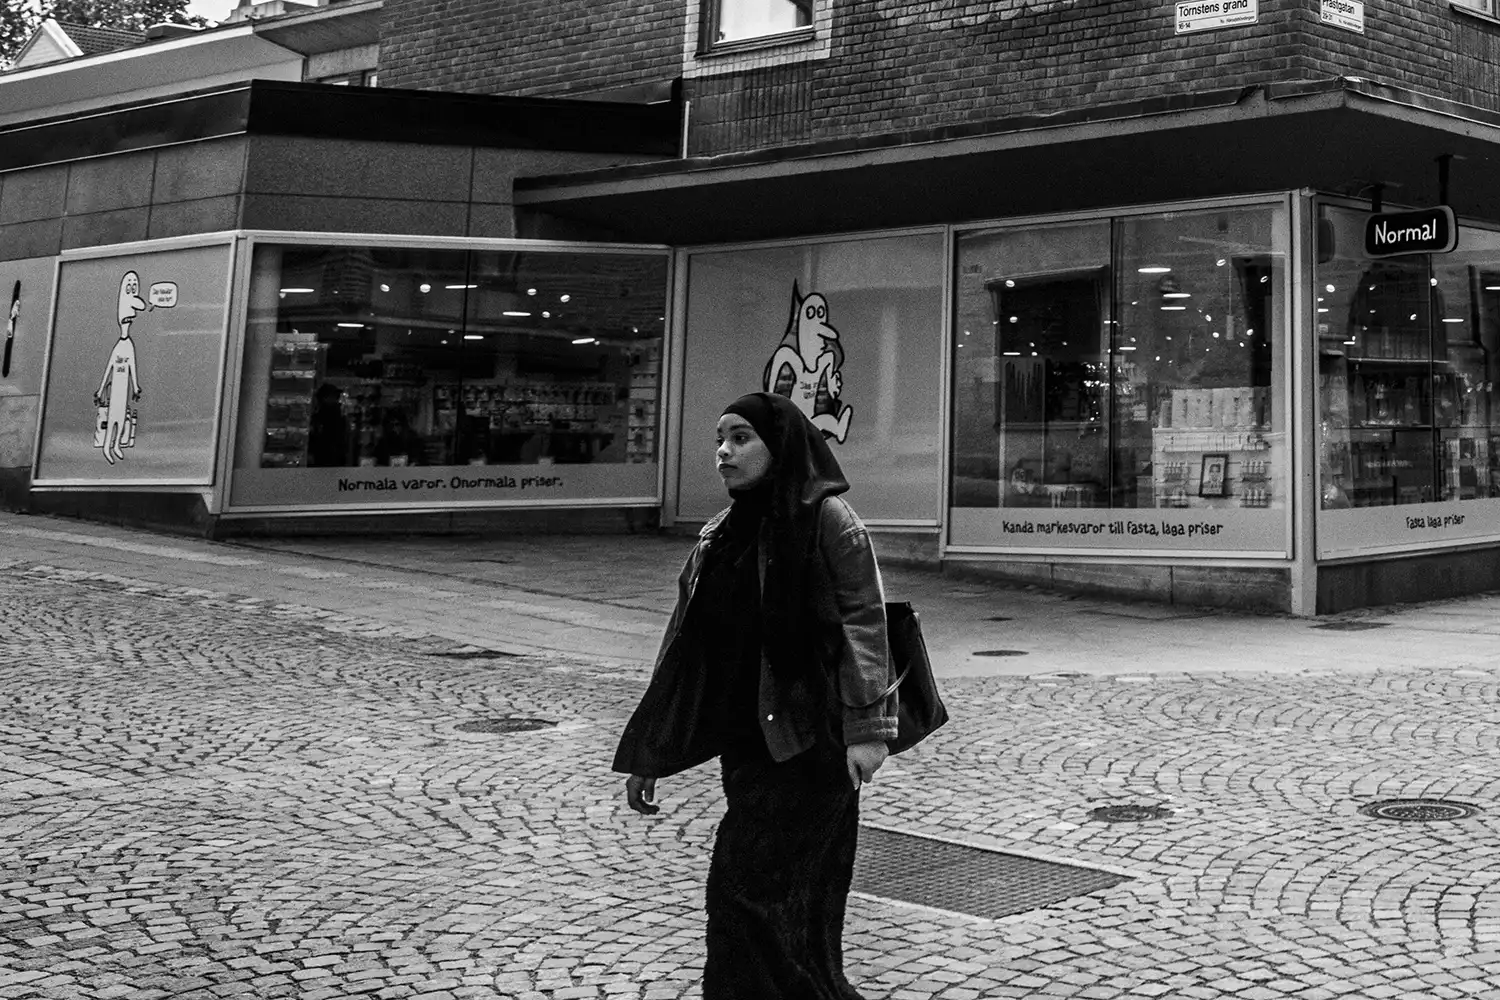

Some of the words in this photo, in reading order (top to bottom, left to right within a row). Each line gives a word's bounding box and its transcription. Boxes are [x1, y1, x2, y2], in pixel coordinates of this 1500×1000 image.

[1375, 218, 1437, 245] Normal
[338, 477, 398, 492] Normala
[401, 479, 447, 490] varor.
[450, 476, 516, 489] Onormala
[521, 476, 563, 490] priser.
[1108, 521, 1124, 534] till
[1127, 521, 1159, 536] fasta,
[1188, 522, 1223, 537] priser
